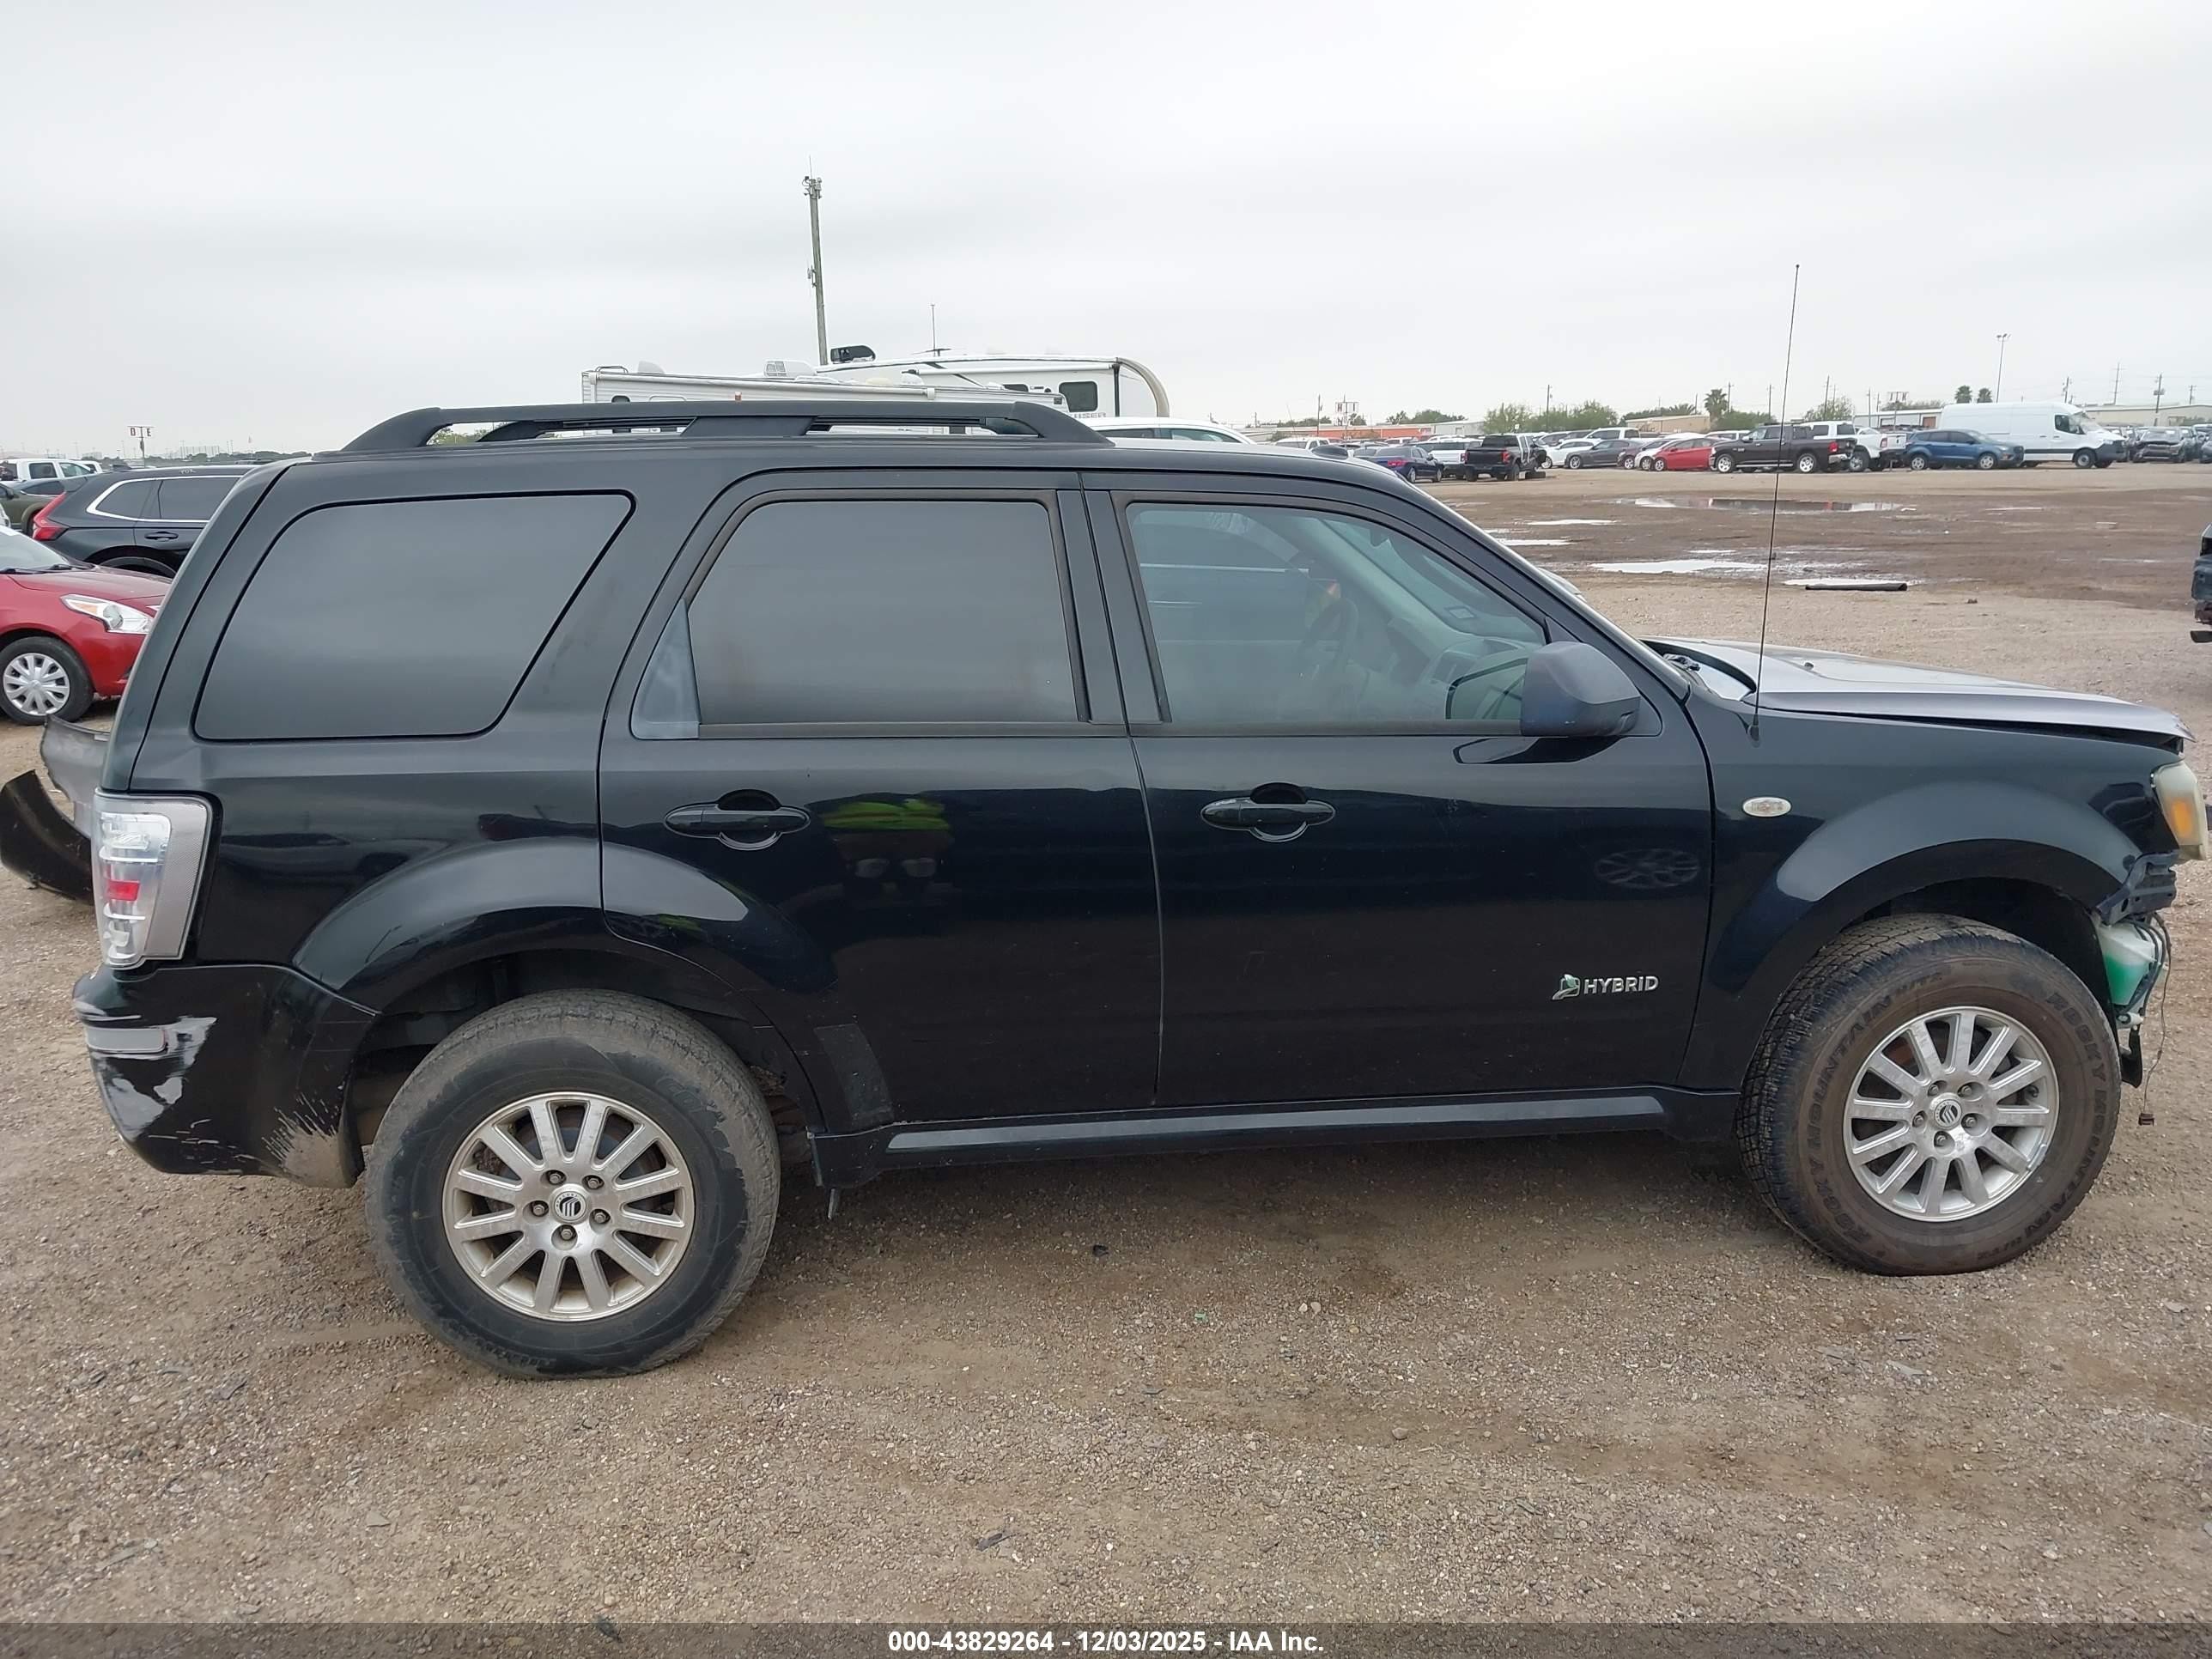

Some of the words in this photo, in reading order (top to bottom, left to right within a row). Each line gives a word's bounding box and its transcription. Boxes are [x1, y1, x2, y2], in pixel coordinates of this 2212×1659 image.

[1583, 975, 1659, 994] HYBRID
[1806, 994, 1891, 1150] MOUNTAIN
[2046, 992, 2106, 1082] ROCKY
[1808, 1156, 1871, 1243] ROCKY
